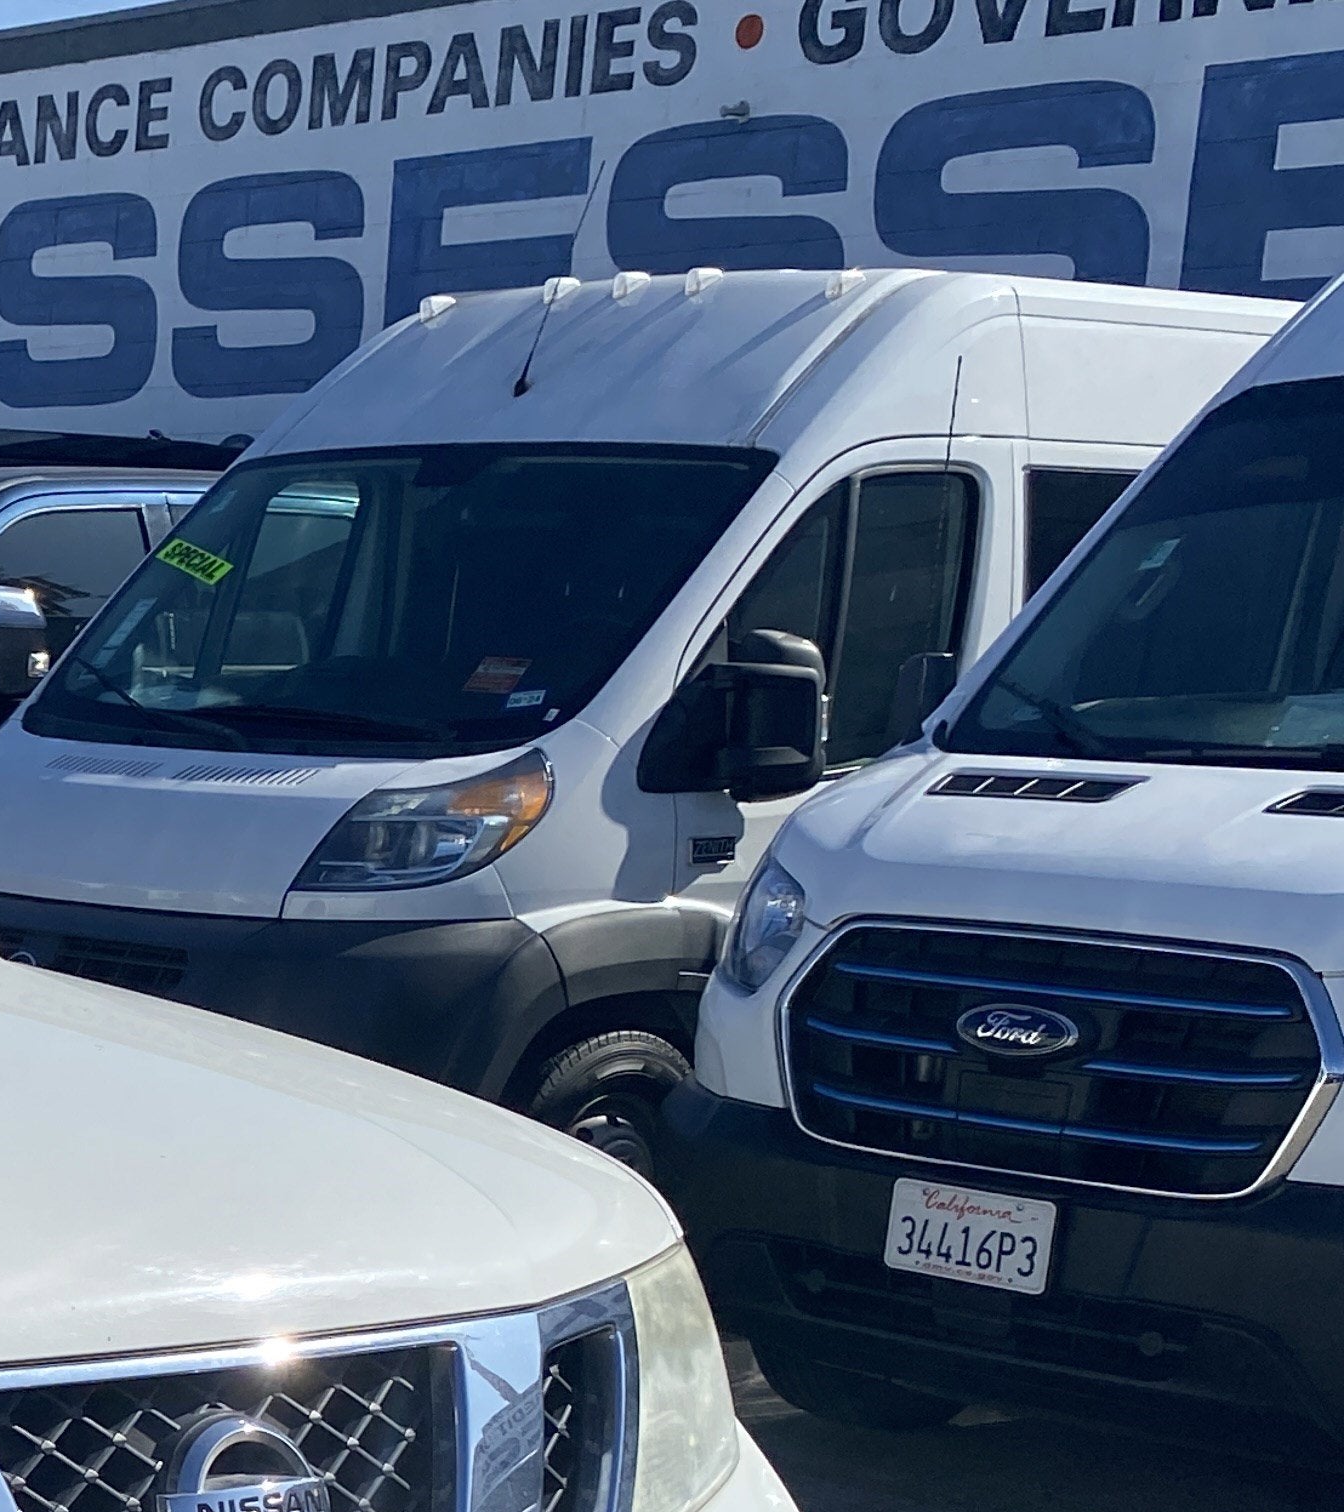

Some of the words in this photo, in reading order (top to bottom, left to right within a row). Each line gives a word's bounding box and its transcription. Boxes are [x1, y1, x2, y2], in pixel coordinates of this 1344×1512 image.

[199, 0, 699, 142] COMPANIES
[976, 1010, 1047, 1045] Ford
[924, 1189, 1022, 1224] California
[896, 1215, 1038, 1278] 34416P3
